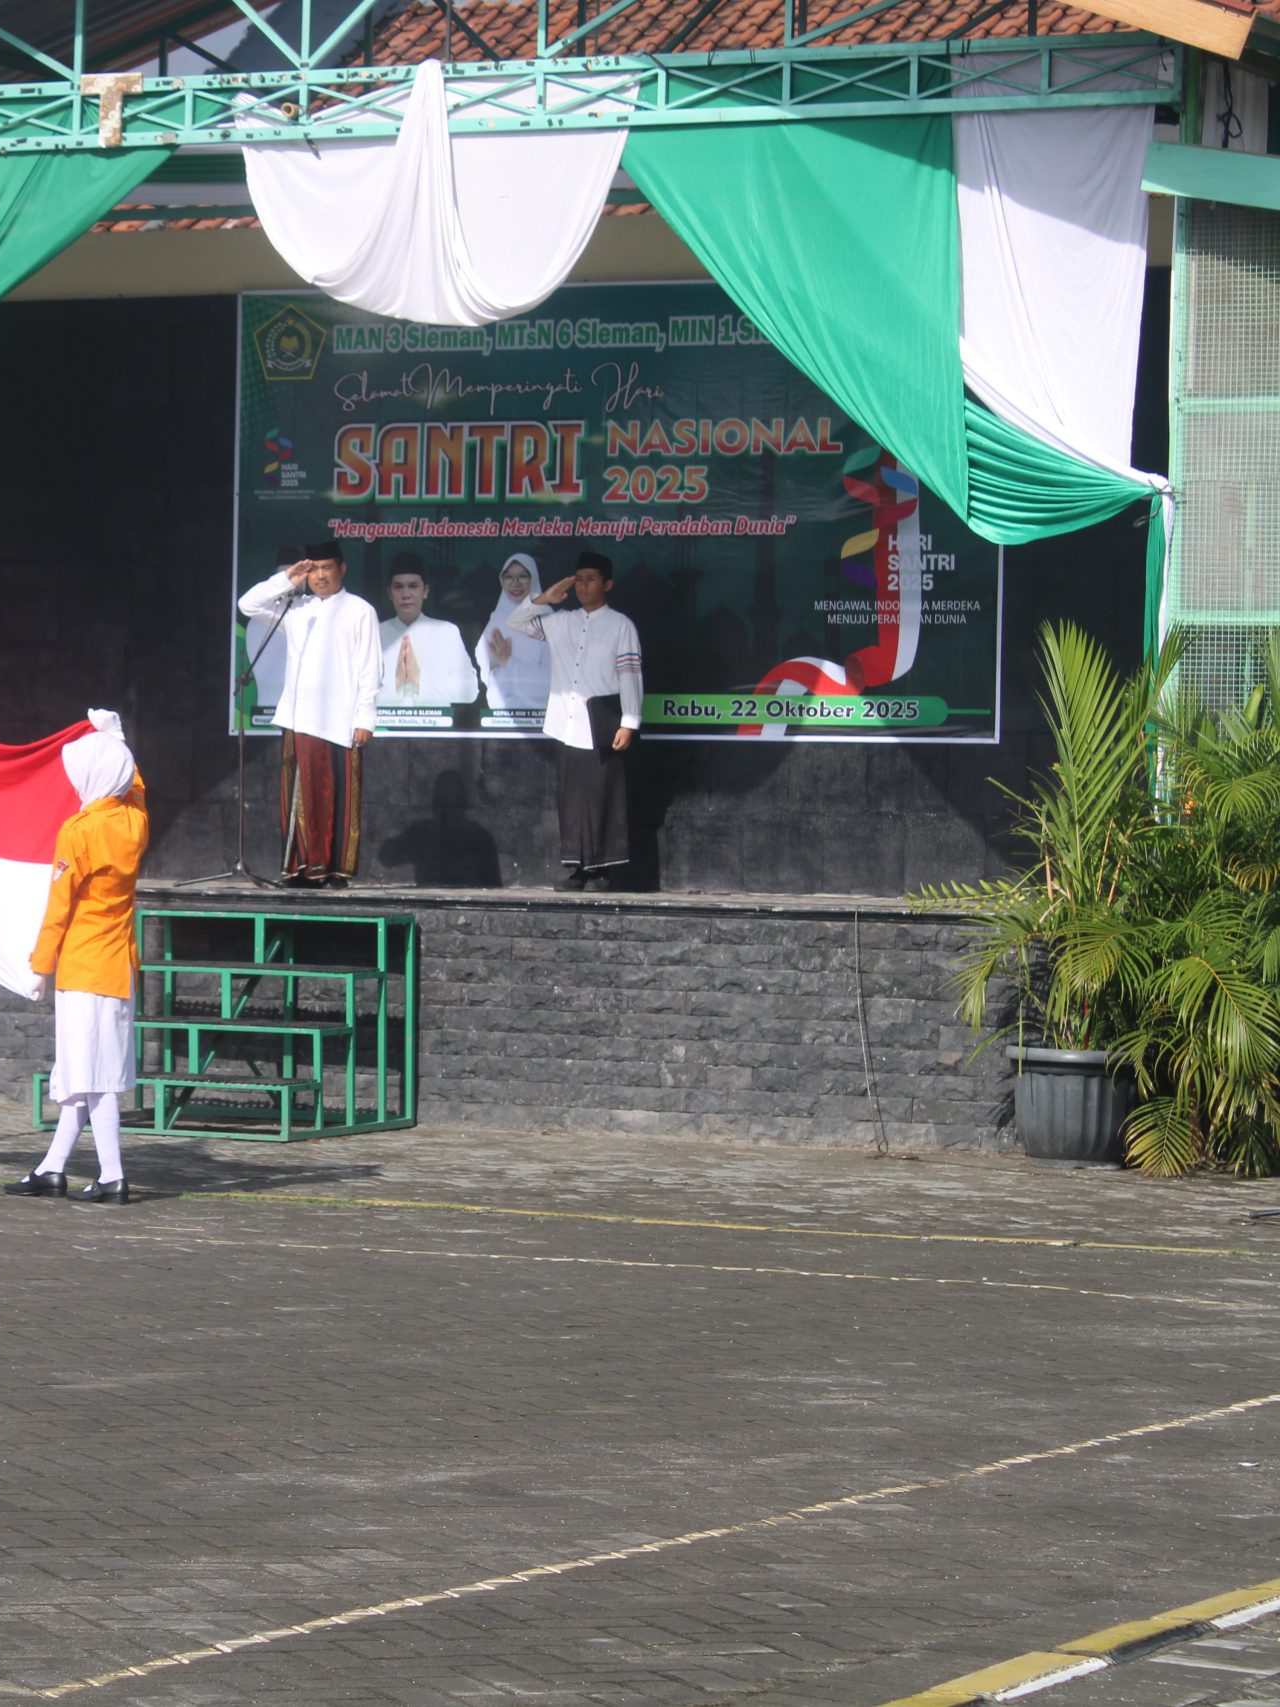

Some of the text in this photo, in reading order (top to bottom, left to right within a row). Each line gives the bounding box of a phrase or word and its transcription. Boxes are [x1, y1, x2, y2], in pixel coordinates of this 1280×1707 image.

[334, 324, 384, 353] MAN
[385, 323, 405, 351] 3
[404, 321, 493, 355] Sleman,
[496, 319, 554, 350] MTsN
[556, 318, 572, 349] 6
[575, 318, 666, 352] Sleman,
[669, 316, 715, 346] MIN
[718, 315, 735, 345] 1
[334, 362, 664, 416] Selamat Memperingati Hari
[606, 417, 843, 457] NASIONAL
[333, 420, 587, 502] SANTRI
[602, 465, 709, 503] 2025
[417, 517, 499, 538] Indonesia
[502, 516, 573, 537] Merdeka
[575, 517, 636, 541] Menuju
[639, 515, 732, 537] Peradaban
[887, 554, 956, 571] SANTRI
[887, 574, 934, 591] 2025
[814, 600, 872, 611] MENGAWAL
[931, 600, 981, 611] MERDEKA
[827, 613, 869, 625] MENUJU
[934, 613, 967, 625] DUNIA
[662, 699, 919, 720] Rabu, 22 Oktober 2025
